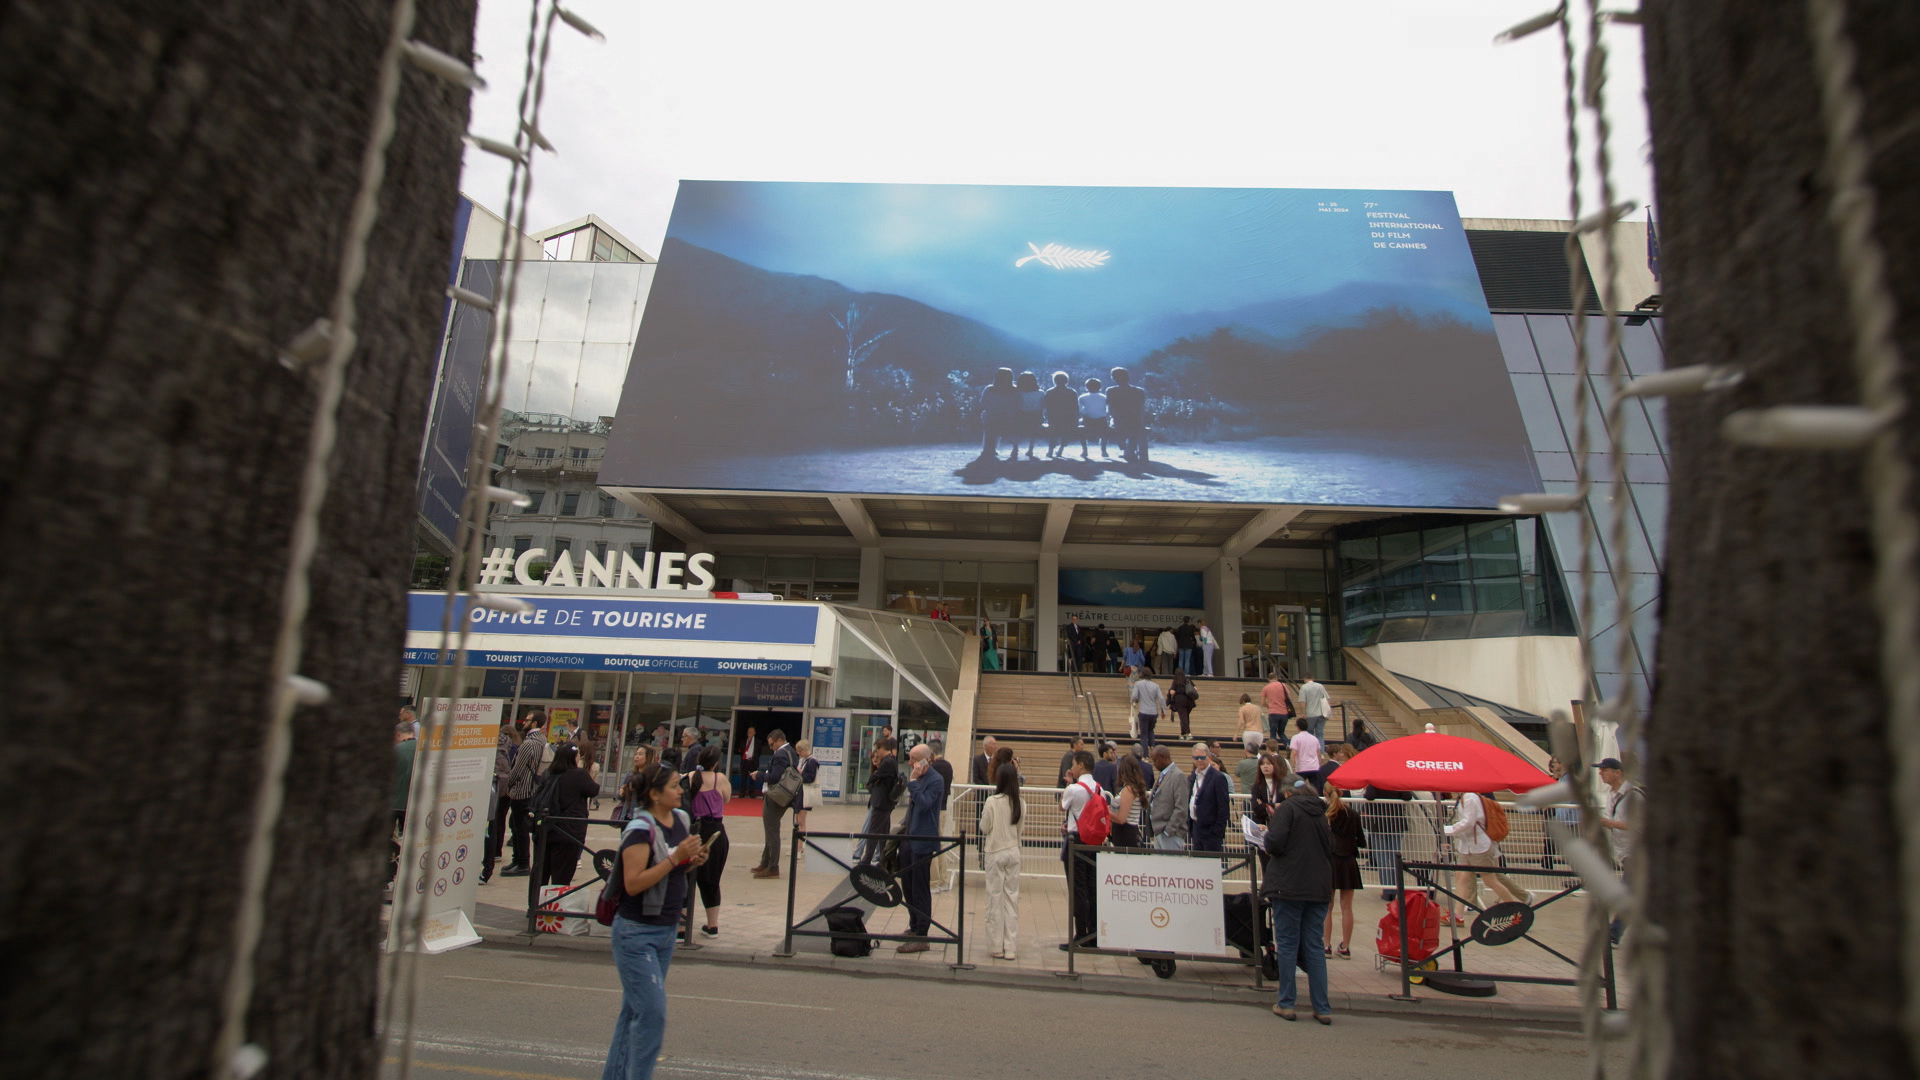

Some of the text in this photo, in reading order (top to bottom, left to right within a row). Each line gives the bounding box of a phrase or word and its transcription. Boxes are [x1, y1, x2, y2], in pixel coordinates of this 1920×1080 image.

[1369, 222, 1444, 230] INTERNATIONAL
[1389, 242, 1427, 250] CANNES
[480, 548, 716, 592] #CANNES
[554, 610, 584, 626] DE
[591, 611, 707, 630] TOURISME
[1112, 613, 1150, 622] CLAUDE
[1153, 614, 1195, 623] DEBUSY
[486, 654, 585, 665] TOURIST INFORMATION
[604, 658, 699, 669] BOUTIQUE OFFICIELLE
[717, 661, 793, 671] SOUVENIRS SHOP
[500, 673, 539, 684] SOTIE
[754, 682, 798, 694] ENTRÉE
[1405, 760, 1464, 770] SCREEN
[1105, 873, 1214, 890] ACCRÉDITATIONS
[1111, 889, 1208, 906] REGISTRATIONS
